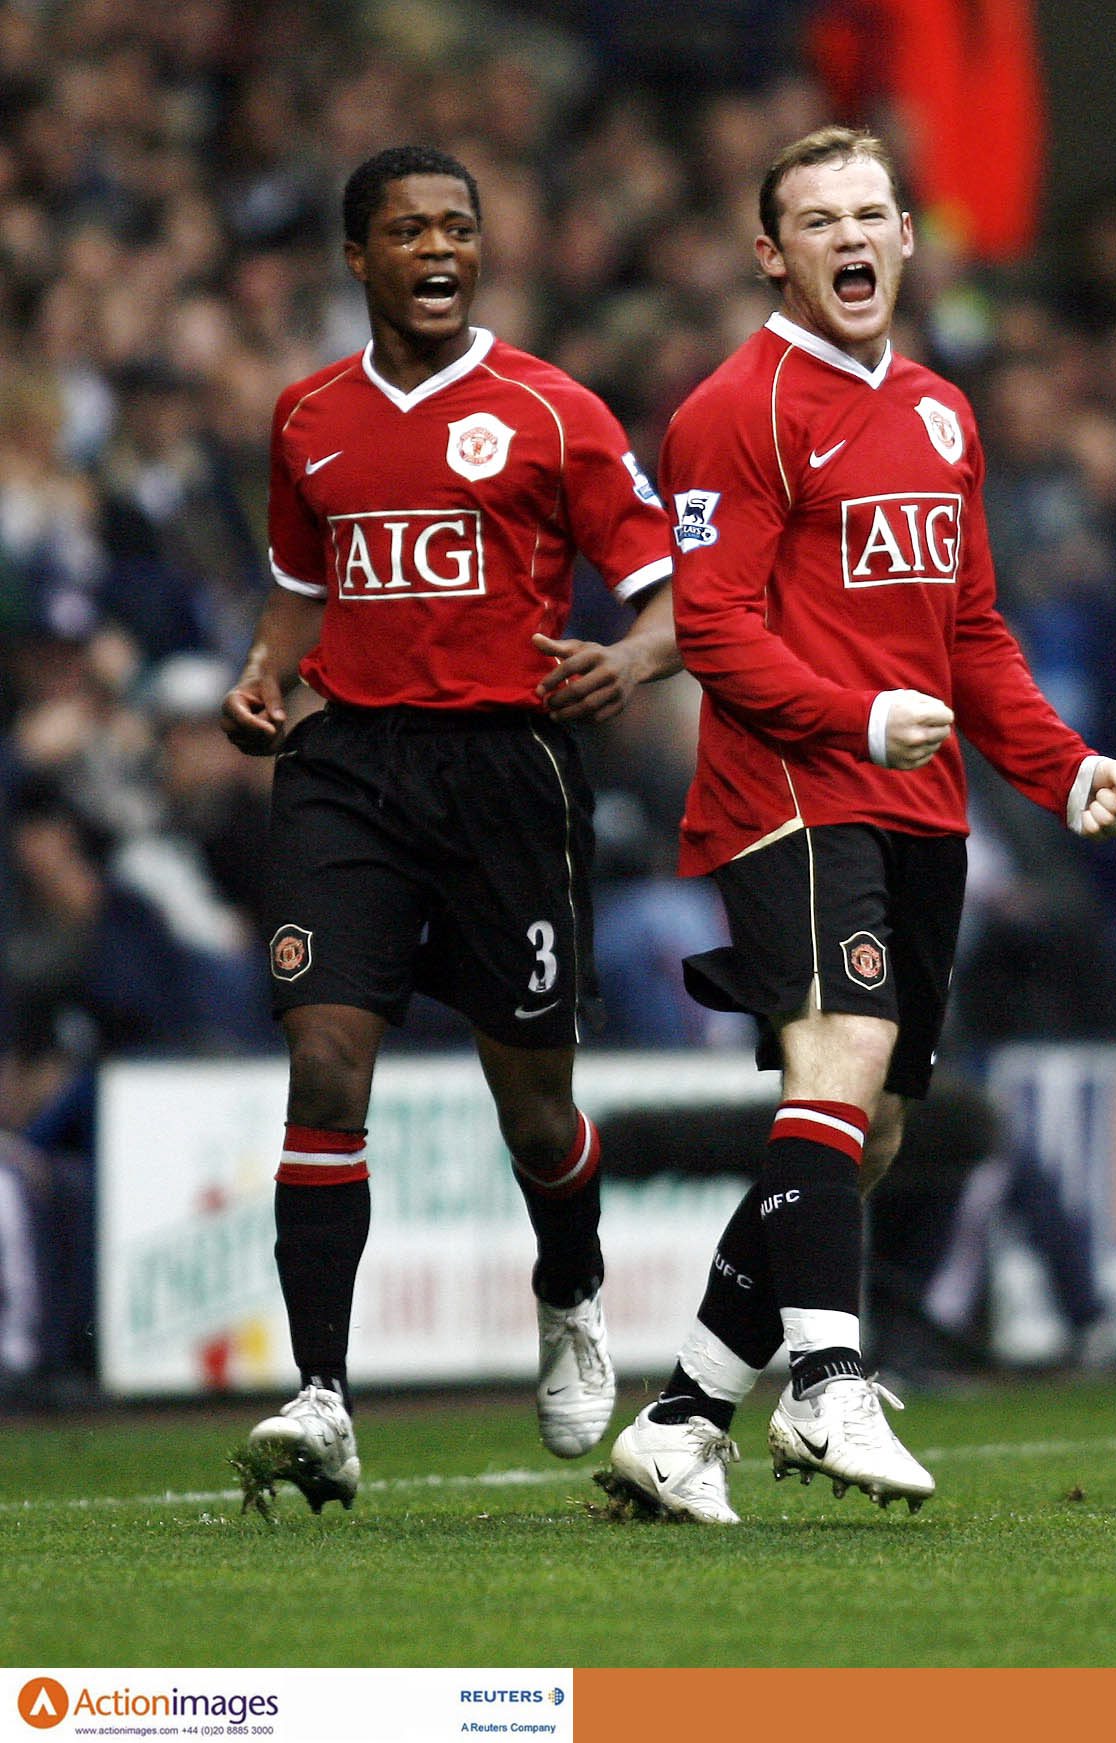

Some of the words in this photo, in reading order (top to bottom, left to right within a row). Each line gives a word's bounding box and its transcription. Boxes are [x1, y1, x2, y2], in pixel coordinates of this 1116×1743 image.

[343, 520, 474, 589] AIG
[852, 504, 956, 576] AIG
[526, 920, 558, 993] 3
[714, 1248, 754, 1289] UFC
